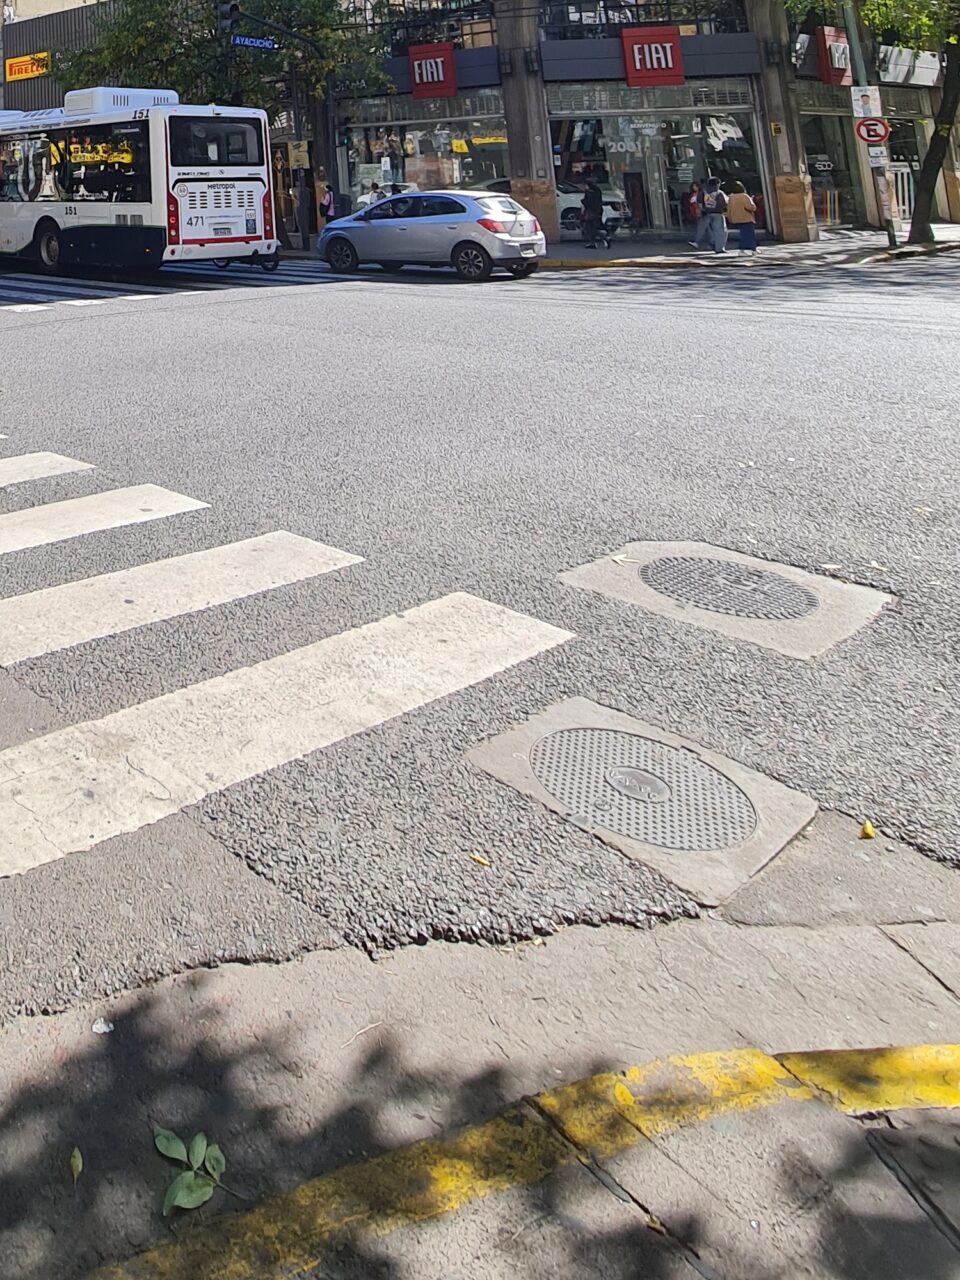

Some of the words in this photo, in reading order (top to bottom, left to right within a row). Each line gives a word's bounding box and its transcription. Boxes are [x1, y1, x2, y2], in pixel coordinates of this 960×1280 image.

[235, 36, 273, 48] AYACUCHO
[633, 42, 674, 70] FIAT
[414, 57, 445, 83] FIAT
[132, 108, 150, 120] 151
[65, 207, 77, 215] 151
[186, 216, 204, 227] 471
